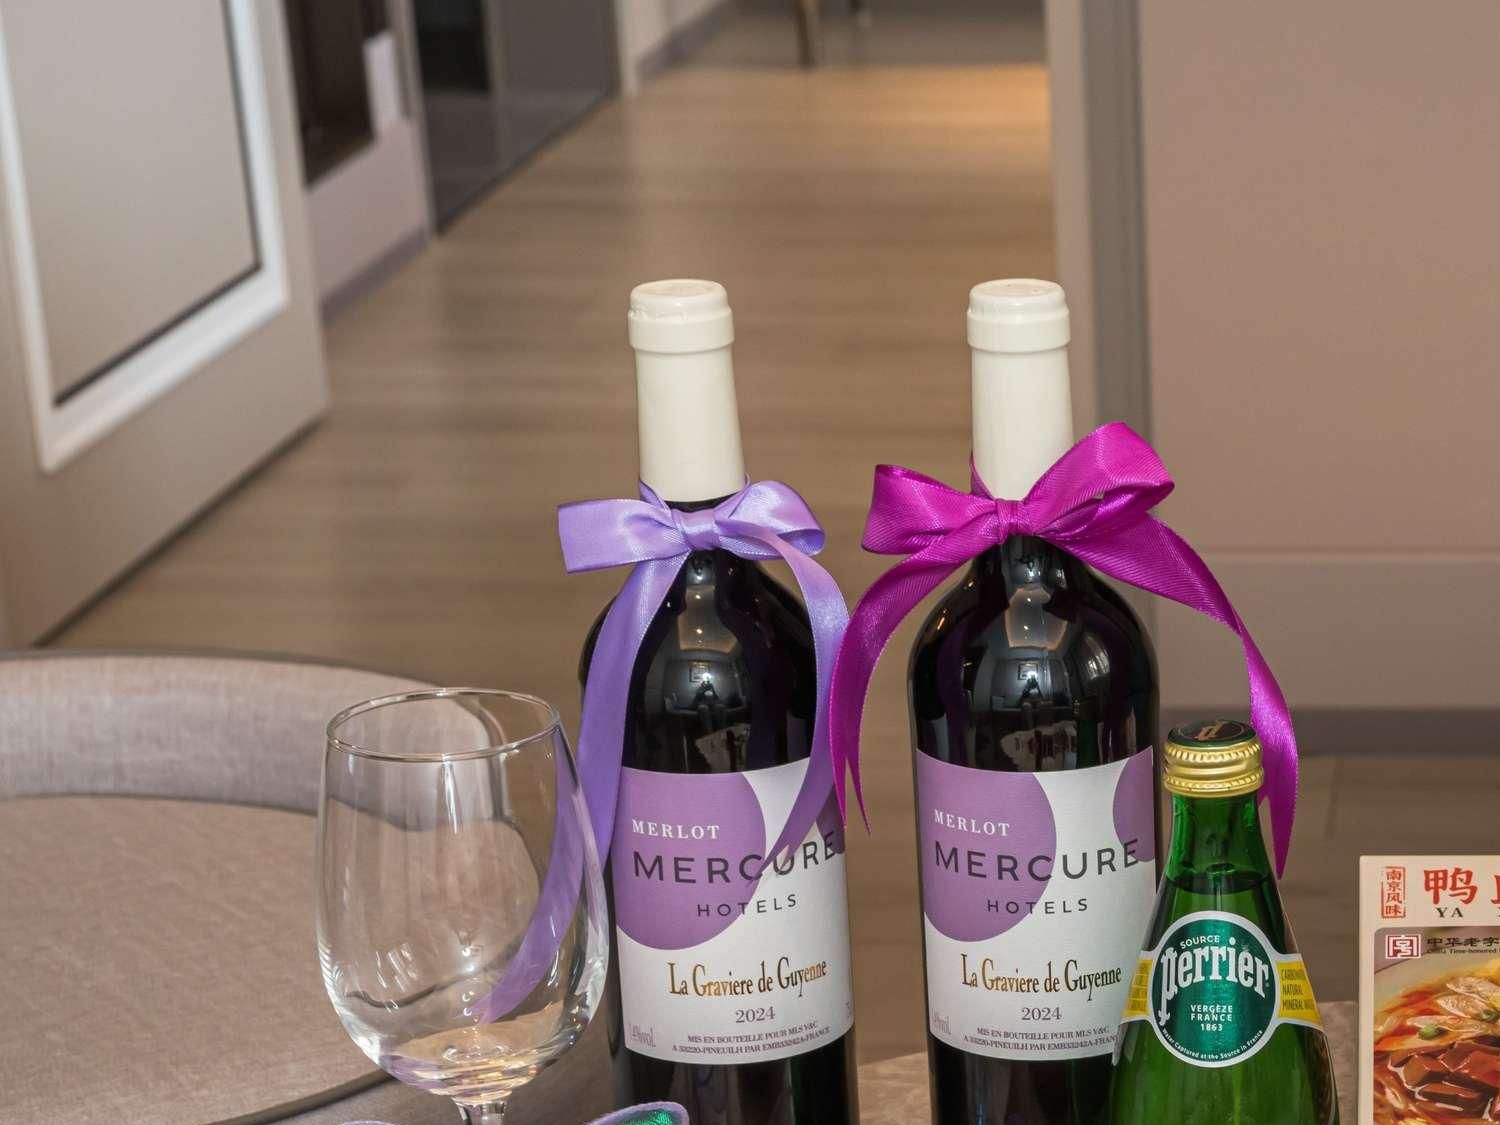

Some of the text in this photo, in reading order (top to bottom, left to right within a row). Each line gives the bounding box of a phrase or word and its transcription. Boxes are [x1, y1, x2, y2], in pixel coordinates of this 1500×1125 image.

[632, 819, 720, 839] MERLOT
[934, 809, 1010, 836] MERLOT
[633, 831, 836, 883] MERCURE
[935, 838, 1138, 882] MERCURE
[1385, 870, 1402, 916] 南京风味
[697, 894, 796, 917] HOTELS
[987, 899, 1088, 914] HOTELS
[1435, 906, 1464, 918] YA
[1180, 935, 1220, 949] SOURCE
[667, 956, 827, 998] La Graviere de Guyenne
[961, 953, 978, 988] La
[981, 958, 1040, 993] Graviere
[1044, 961, 1060, 993] de
[1064, 959, 1122, 1002] Guyenne
[735, 1006, 776, 1024] 2024
[1021, 1006, 1062, 1021] 2024
[1190, 1013, 1233, 1022] FRANCE
[976, 1027, 990, 1036] MIS
[991, 1029, 1002, 1038] EN
[1200, 1023, 1223, 1032] 1863
[688, 1035, 702, 1043] MIS
[703, 1035, 715, 1043] EN
